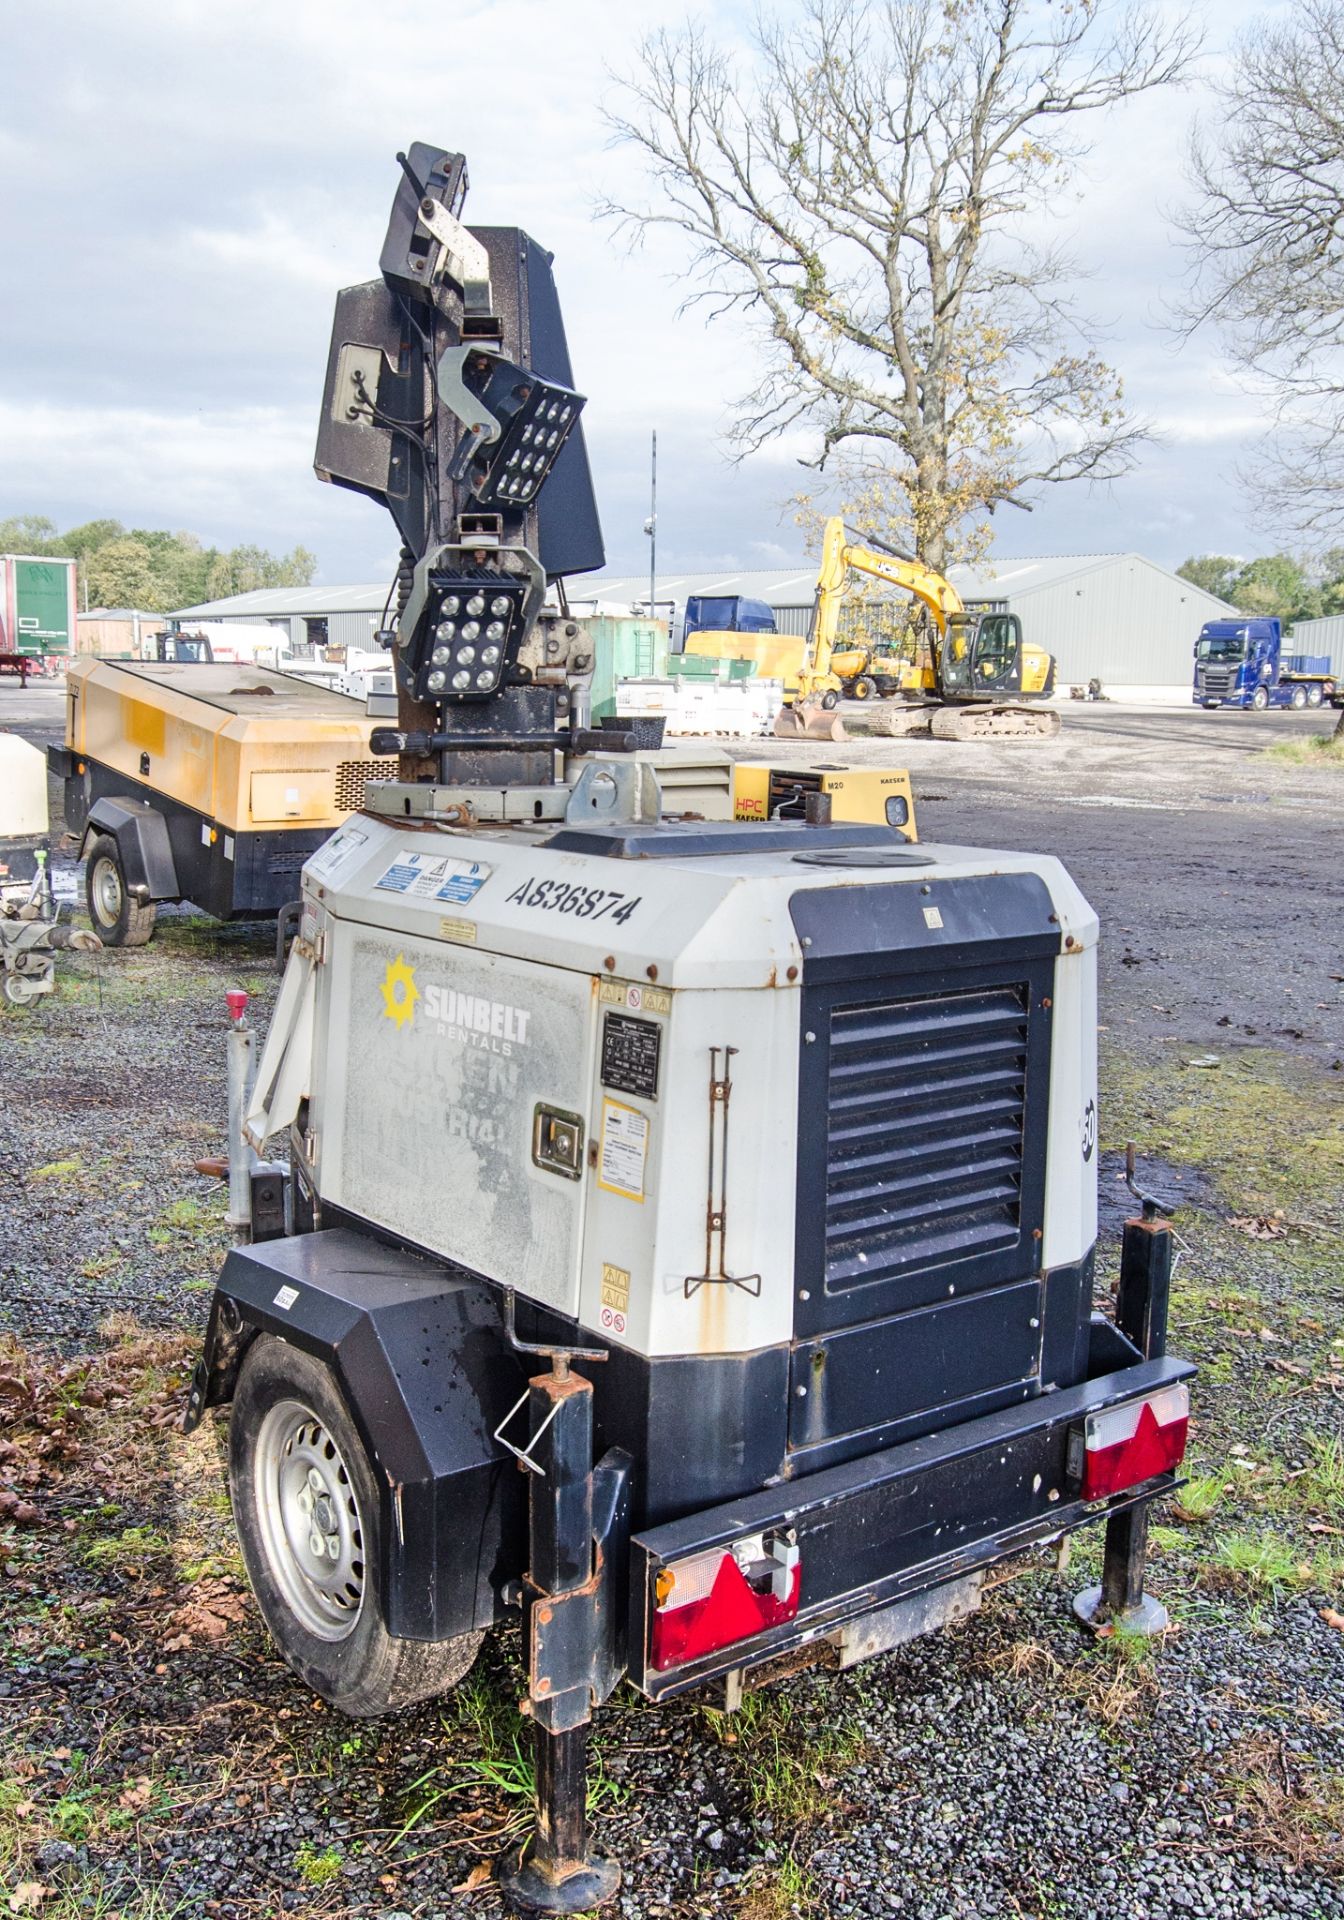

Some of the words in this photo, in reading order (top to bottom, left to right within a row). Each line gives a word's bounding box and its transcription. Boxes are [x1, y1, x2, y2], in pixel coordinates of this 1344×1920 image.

[877, 560, 899, 577] JCB
[828, 782, 844, 790] M20
[880, 777, 905, 785] KAESER
[736, 797, 763, 813] HPC
[424, 985, 531, 1044] SUNBELT
[437, 1022, 512, 1057] RENTALS
